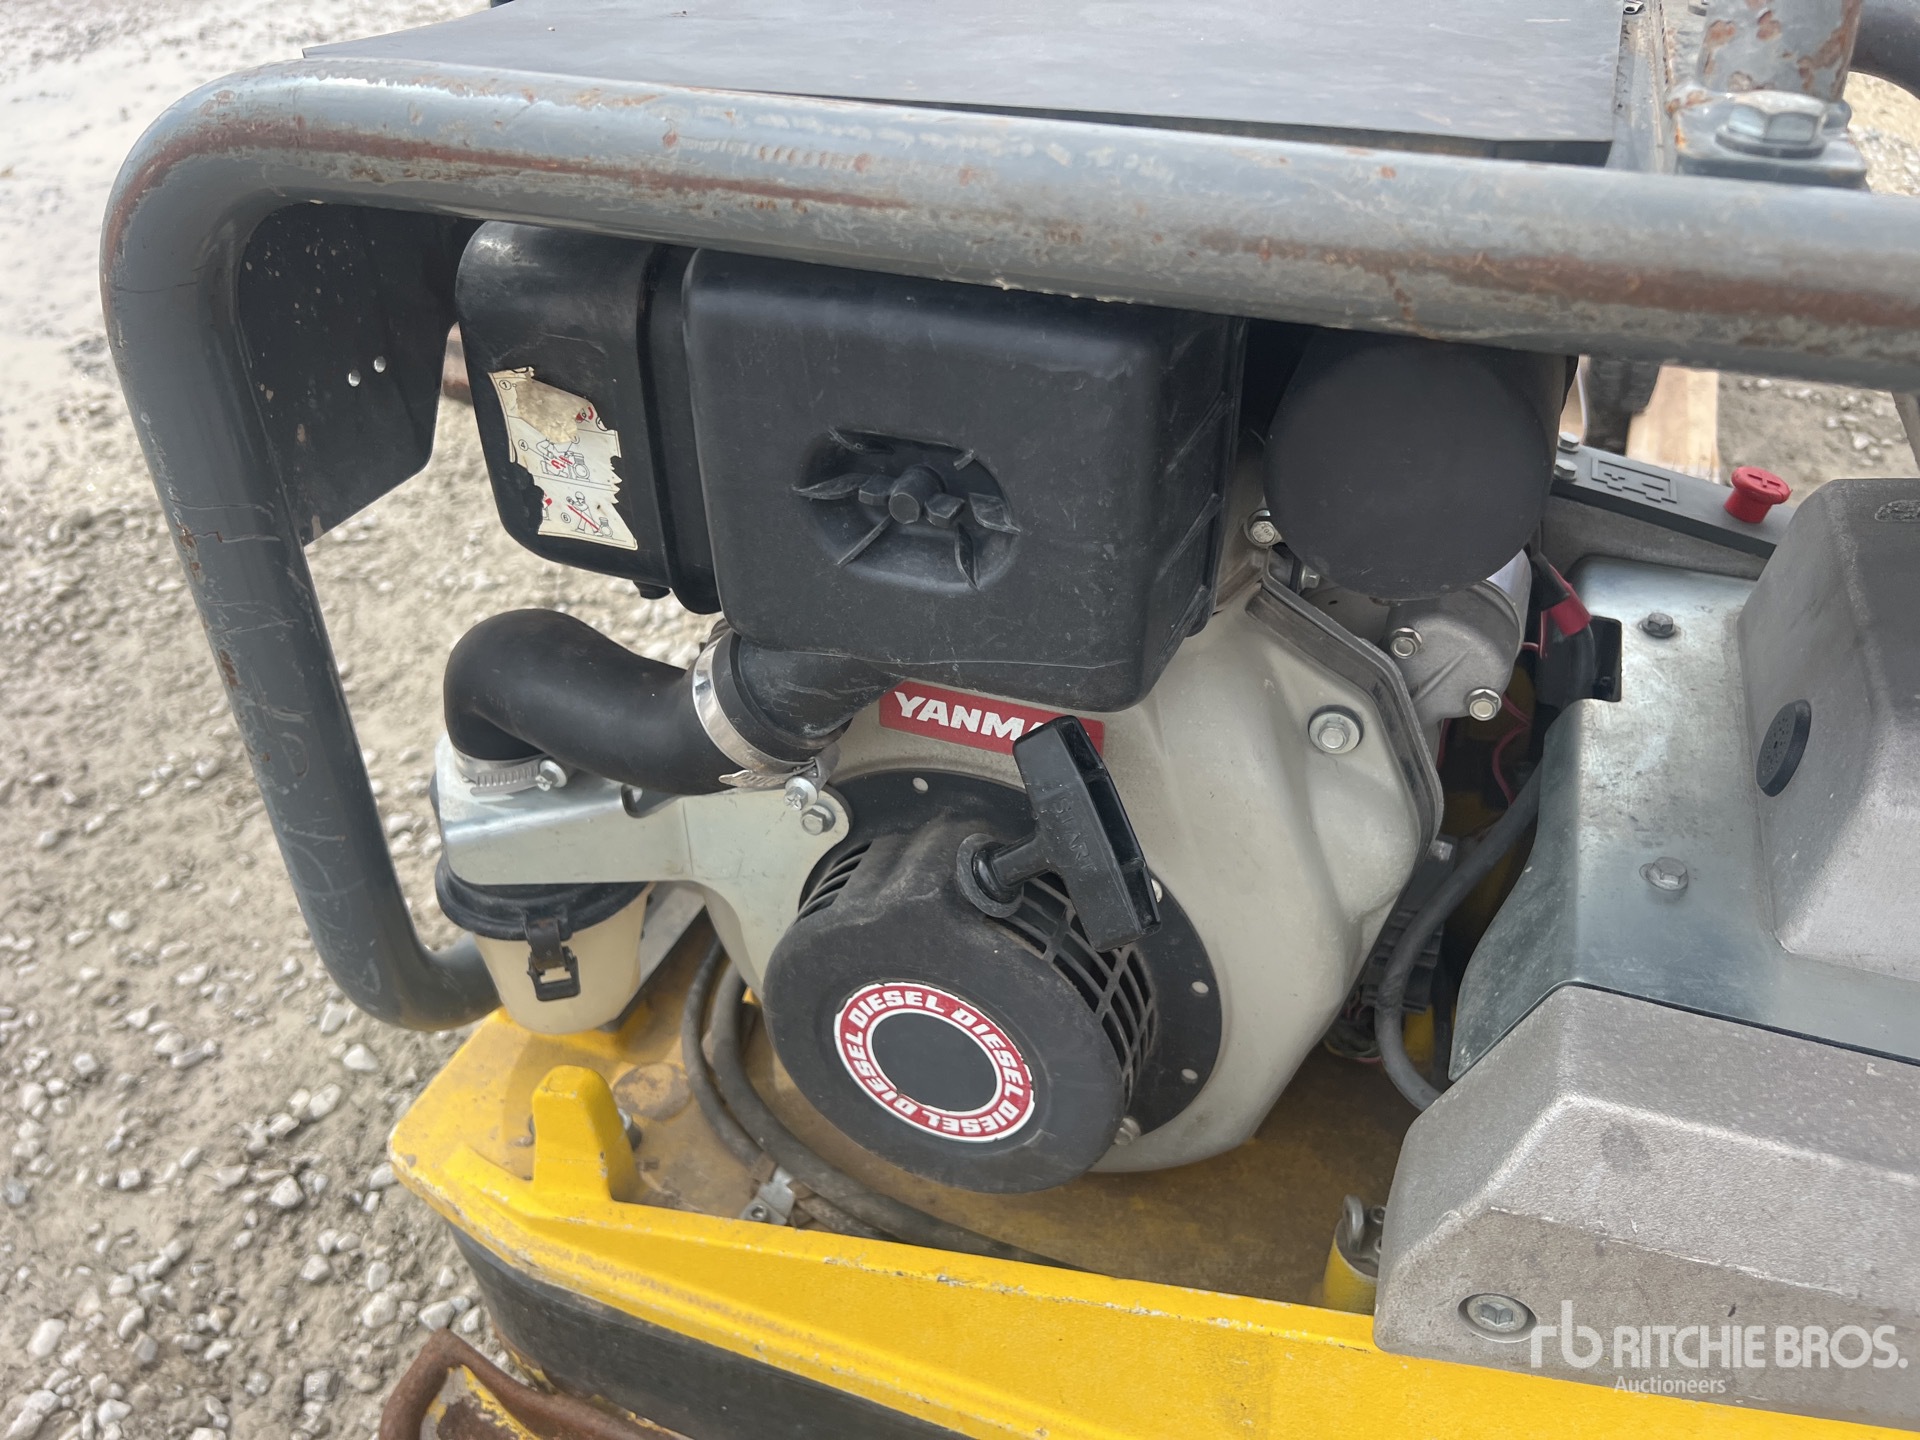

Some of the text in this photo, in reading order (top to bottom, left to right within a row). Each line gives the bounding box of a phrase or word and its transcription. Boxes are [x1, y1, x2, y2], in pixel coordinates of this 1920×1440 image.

[893, 691, 1046, 741] YANM
[845, 989, 1023, 1133] DIESEL DIESEL DIESEL DIESEL
